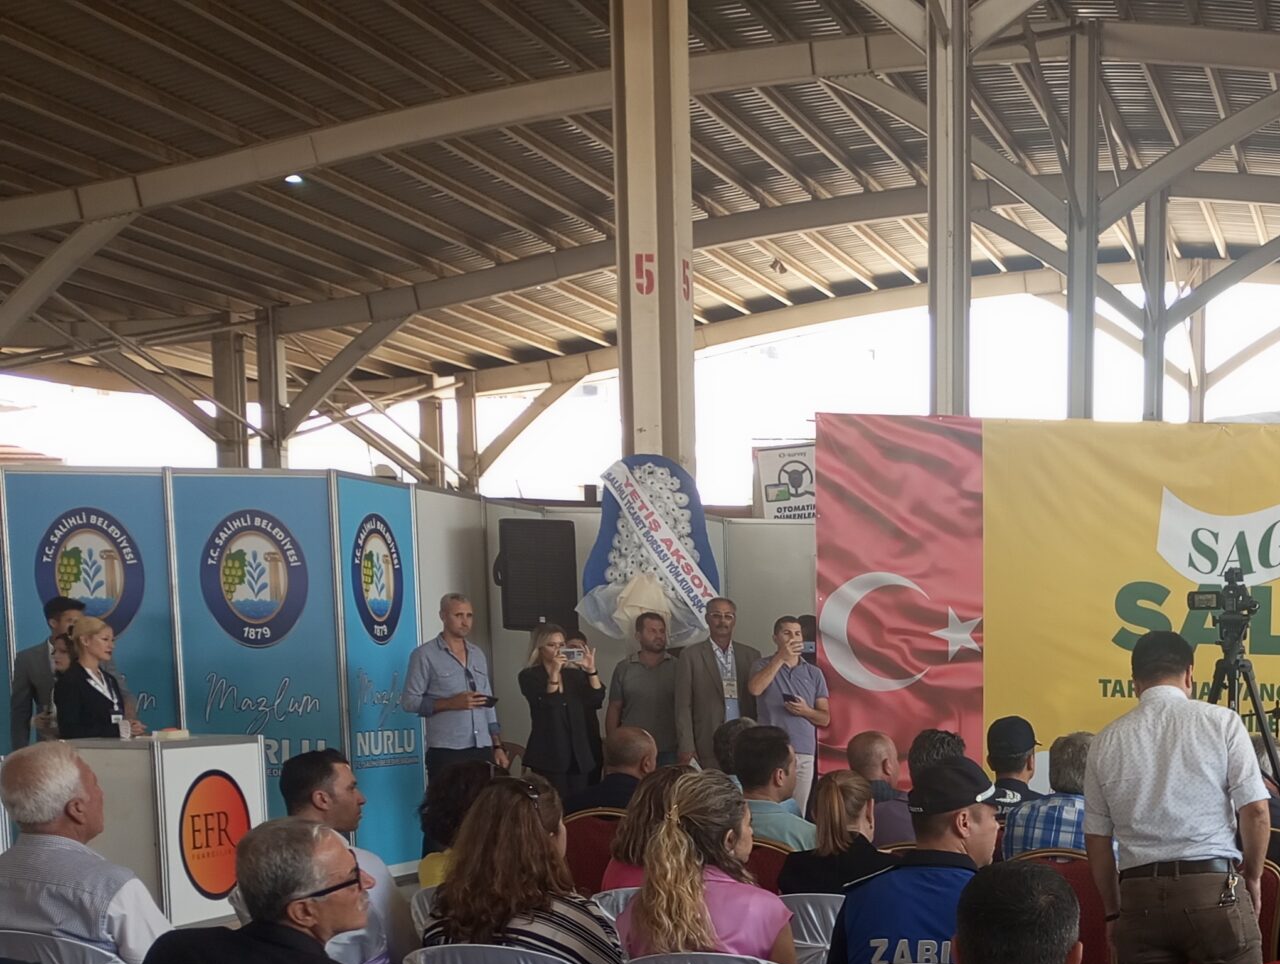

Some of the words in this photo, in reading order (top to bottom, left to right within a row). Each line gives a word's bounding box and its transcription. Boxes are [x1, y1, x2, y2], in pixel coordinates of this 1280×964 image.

[635, 253, 655, 295] 5
[682, 259, 690, 301] 5
[43, 545, 56, 562] T.C.
[50, 512, 87, 543] SALİHLİ
[208, 548, 220, 565] T.C.
[215, 514, 251, 546] SALİHLİ
[643, 530, 670, 563] BORSASI
[660, 536, 714, 598] AKSOY
[243, 627, 271, 640] 1879
[204, 672, 320, 735] Mazlum
[356, 729, 415, 757] NURLU
[190, 811, 237, 850] EFR
